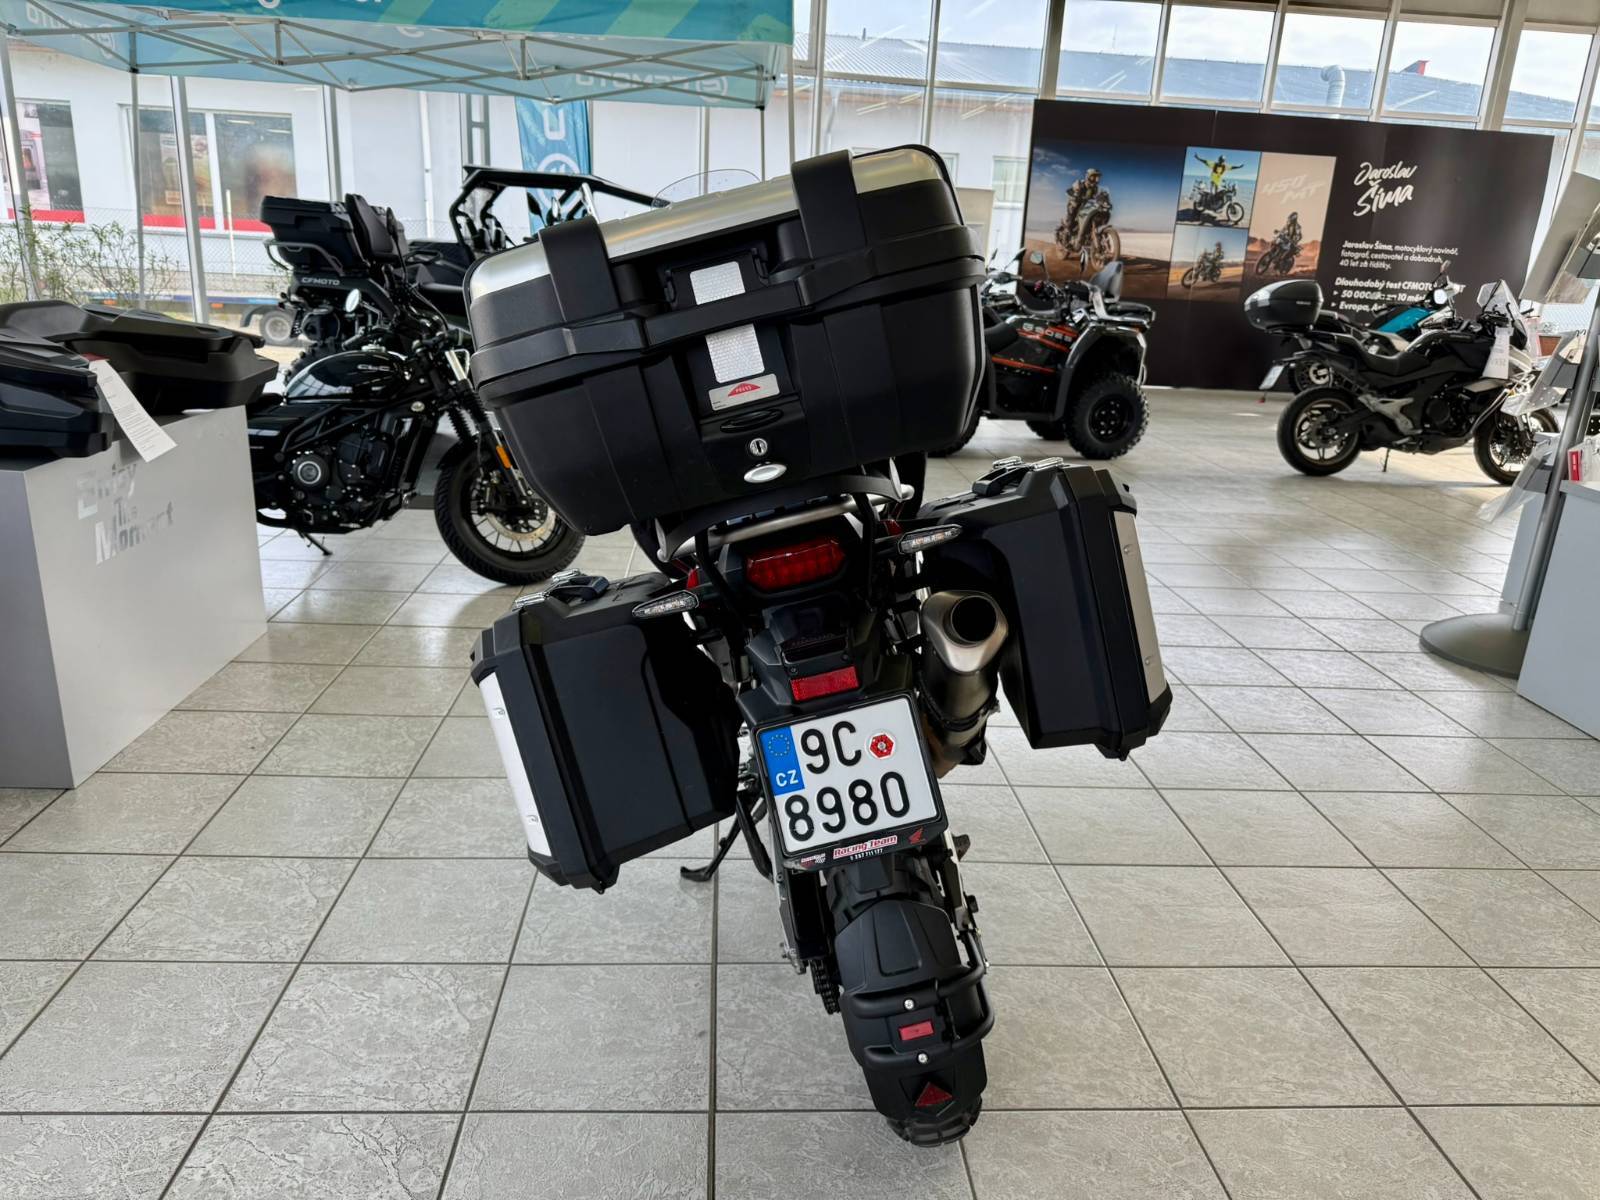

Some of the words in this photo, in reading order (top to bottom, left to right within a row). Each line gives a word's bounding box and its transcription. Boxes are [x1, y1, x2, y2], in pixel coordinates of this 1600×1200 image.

[1353, 161, 1418, 186] Jaroslav
[1342, 240, 1374, 249] Jaroslav
[1394, 244, 1433, 255] motocyklový
[1339, 259, 1349, 267] 40
[1370, 252, 1404, 260] cestovatel
[301, 277, 340, 286] CFMOTO
[1335, 277, 1386, 290] Dlouhodobý
[1386, 280, 1402, 290] test
[1341, 289, 1353, 298] 50
[1397, 292, 1407, 301] 10
[1339, 301, 1371, 312] Evropa,
[800, 720, 862, 775] 9C
[775, 769, 799, 787] CZ
[784, 771, 910, 842] 8980
[833, 842, 868, 859] Racing
[870, 834, 898, 849] Team
